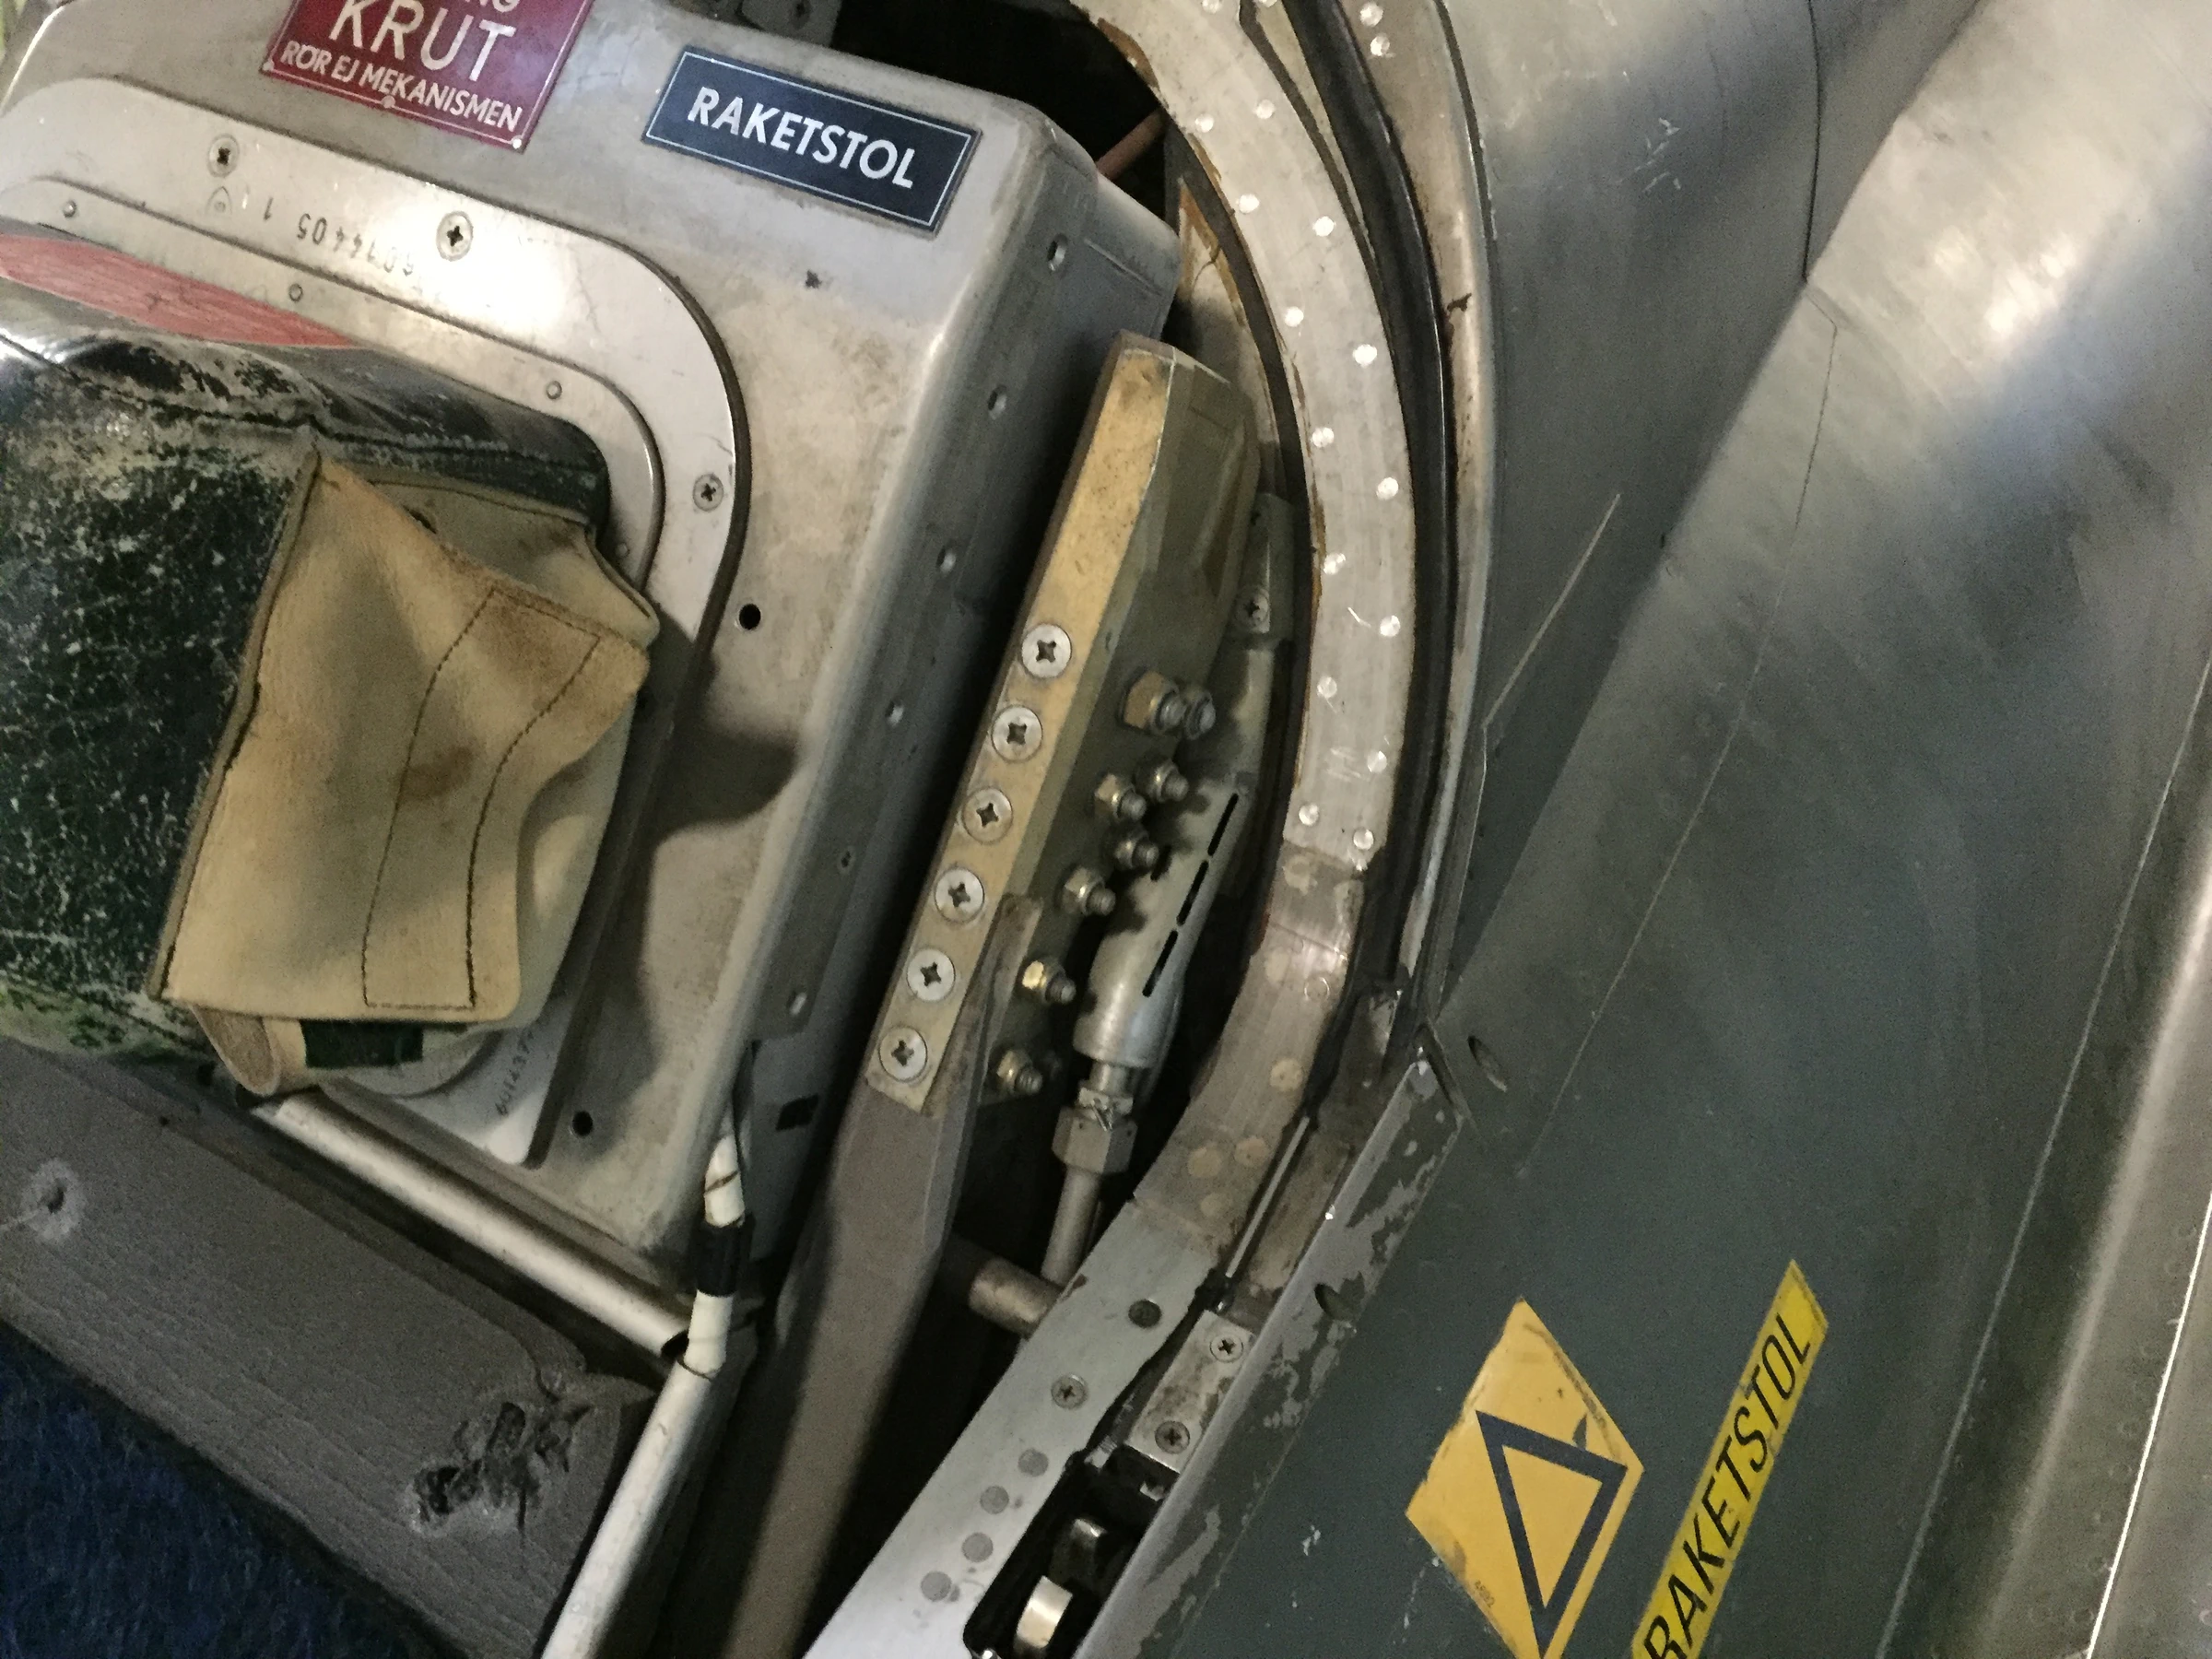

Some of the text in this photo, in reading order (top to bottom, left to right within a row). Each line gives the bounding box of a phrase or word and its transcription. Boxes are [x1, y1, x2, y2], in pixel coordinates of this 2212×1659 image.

[328, 0, 516, 81] KRUT
[331, 55, 359, 83] EJ
[358, 63, 523, 133] MEKANISMEN
[687, 87, 916, 189] RAKETSTOL
[1642, 1312, 1812, 1659] RAKETSTOL
